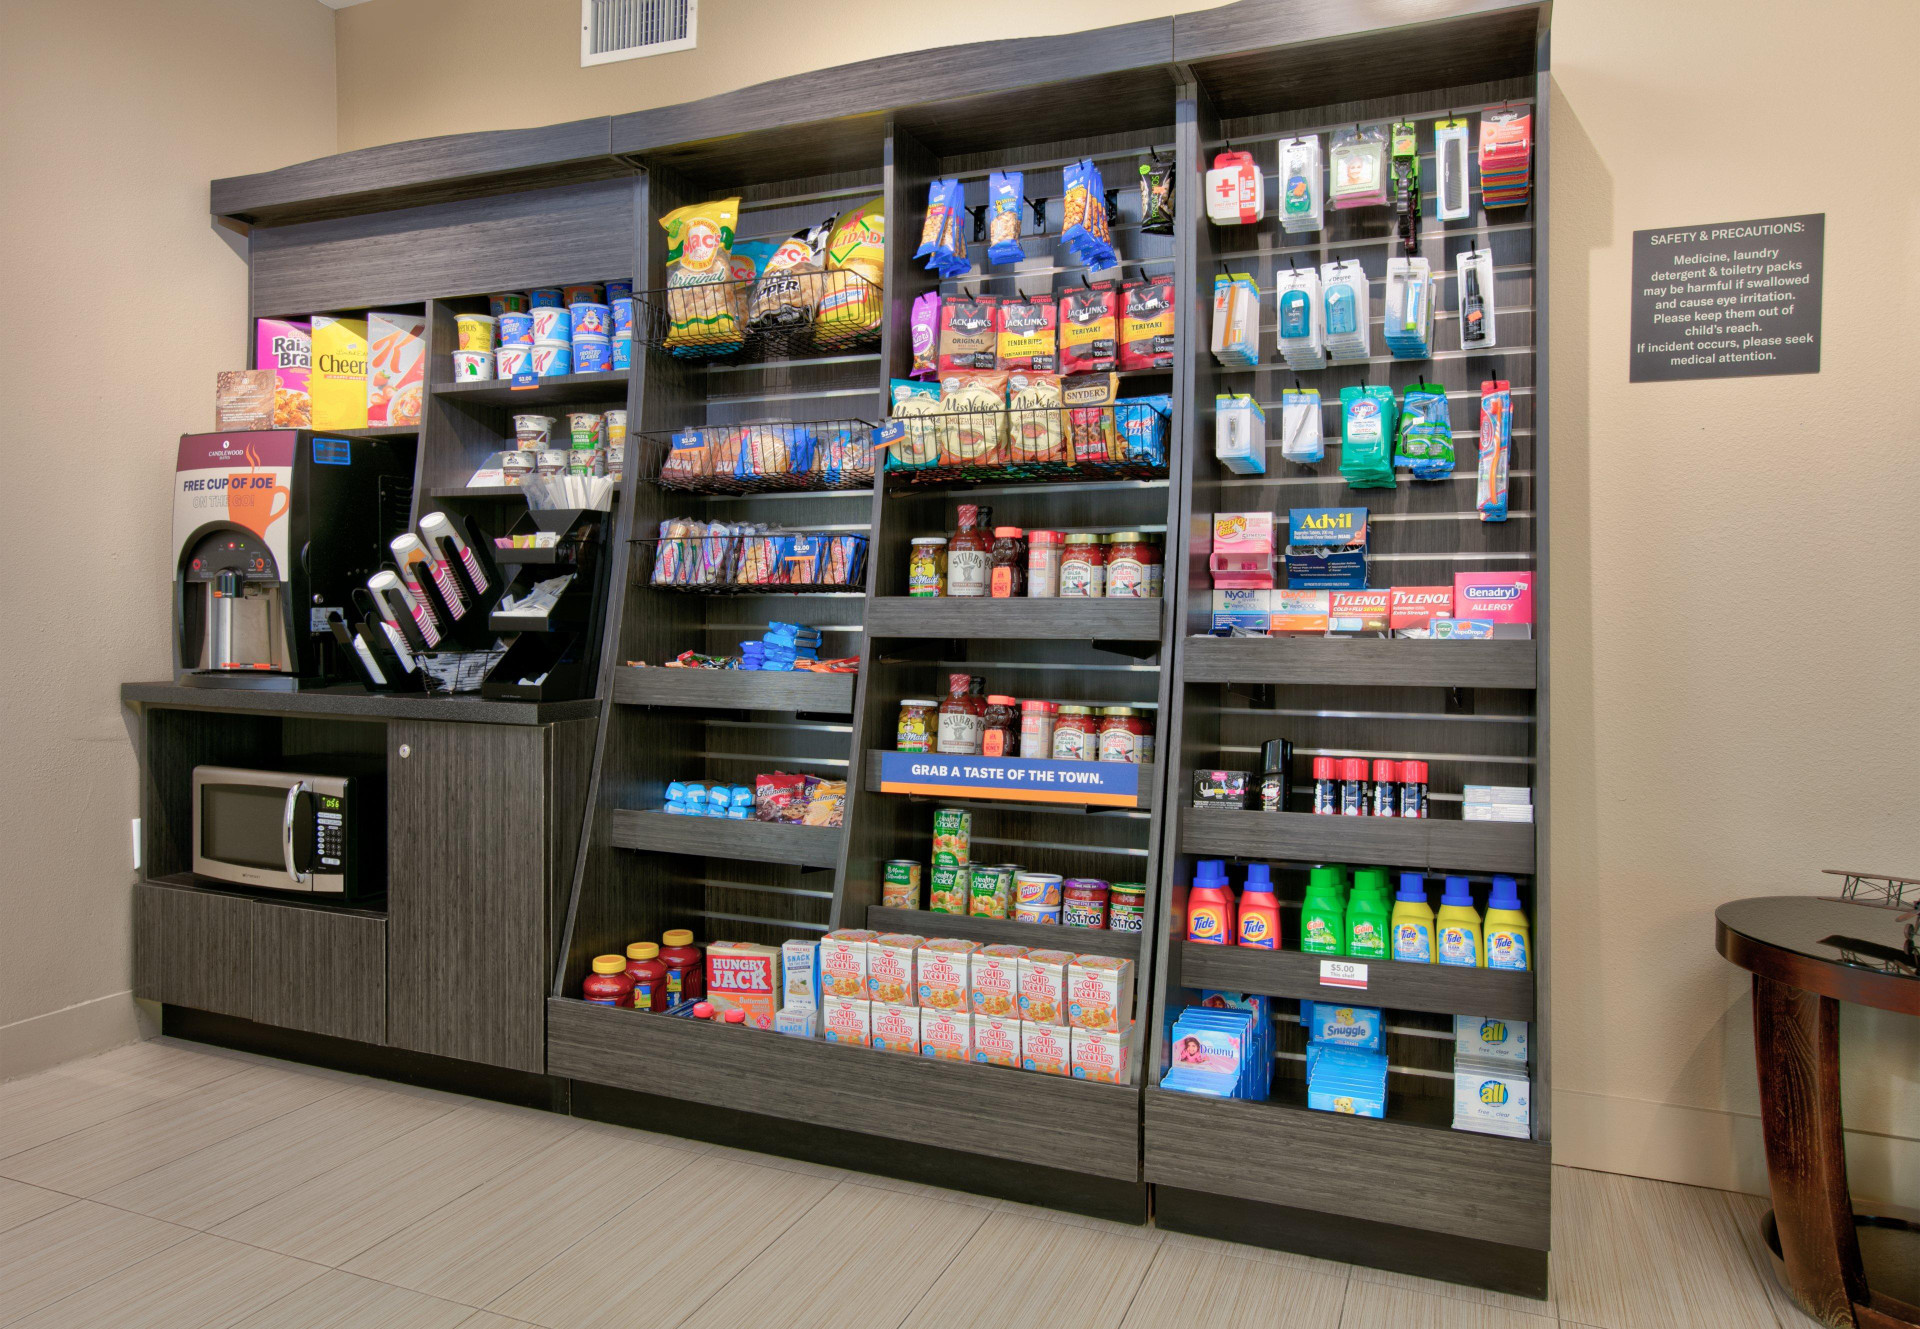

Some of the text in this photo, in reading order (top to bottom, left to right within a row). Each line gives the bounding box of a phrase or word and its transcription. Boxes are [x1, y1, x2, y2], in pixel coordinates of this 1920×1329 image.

[1650, 222, 1805, 246] SAFETY & PRECAUTIONS:
[683, 232, 722, 258] Mac's
[1674, 247, 1779, 266] Medicine, laundry
[1651, 260, 1803, 282] detergent & toiletry packs
[668, 267, 726, 290] Original
[1643, 273, 1810, 298] may be harmful if swallowed
[1655, 291, 1796, 310] and cause eye irritation.
[1067, 309, 1084, 318] JACK
[1126, 304, 1144, 314] JACK
[1653, 304, 1795, 324] Please keep them out of
[948, 318, 968, 327] JACK
[1005, 318, 1023, 328] JACK
[1131, 321, 1162, 331] TERIYAKI
[1072, 326, 1101, 335] TERIYAKI
[1684, 322, 1763, 336] child's reach.
[1637, 333, 1814, 353] If incident occurs, please seek
[1670, 350, 1777, 366] medical attention.
[1066, 387, 1107, 400] SNYDER'S
[943, 394, 1000, 416] Miss Vickie's
[881, 427, 898, 438] $2.00
[681, 436, 697, 444] $2.00
[208, 449, 244, 457] CANDLEWOOD
[183, 477, 273, 492] FREE CUP OF JOE
[192, 494, 255, 509] ON THE GO!
[1300, 513, 1353, 529] Advil
[793, 543, 810, 552] $2.00
[1224, 590, 1255, 601] NyQuil
[1280, 589, 1317, 599] DayQuil
[1332, 593, 1388, 606] TYLENOL
[1392, 591, 1451, 605] TYLENOL
[1469, 587, 1515, 600] Benadryl
[1471, 603, 1514, 611] ALLERGY
[911, 764, 1104, 785] GRAB A TASTE OF THE TOWN.
[936, 820, 959, 828] Choice
[933, 876, 954, 885] Choice
[972, 880, 995, 889] Choice
[1064, 910, 1101, 925] TOSTITOS
[1193, 916, 1215, 932] Tide
[1243, 919, 1265, 935] Tide
[1306, 920, 1325, 931] Gain
[1353, 924, 1374, 935] Gain
[1400, 929, 1417, 940] Tide
[1446, 933, 1462, 944] Tide
[1495, 937, 1513, 949] Tide
[787, 954, 811, 962] SNACK
[834, 953, 852, 962] CUP
[879, 957, 898, 967] CUP
[712, 958, 766, 971] HUNGRY
[826, 960, 860, 972] NOODLES
[872, 964, 905, 977] NOODLES
[932, 963, 952, 973] CUP
[1330, 963, 1355, 973] $5.00
[711, 970, 770, 990] JACK
[923, 971, 959, 983] NOODLES
[984, 969, 1004, 979] CUP
[1030, 974, 1049, 985] CUP
[977, 976, 1010, 988] NOODLES
[1082, 981, 1103, 991] CUP
[1022, 981, 1055, 996] NOODLES
[1074, 988, 1110, 1001] NOODLES
[836, 1010, 855, 1019] CUP
[885, 1016, 905, 1025] CUP
[829, 1016, 863, 1028] NOODLES
[935, 1023, 955, 1033] CUP
[877, 1023, 912, 1035] NOODLES
[987, 1030, 1006, 1040] CUP
[1327, 1025, 1366, 1038] Snuggle
[1481, 1023, 1505, 1041] all
[927, 1029, 962, 1042] NOODLES
[980, 1037, 1013, 1050] NOODLES
[1035, 1037, 1055, 1047] CUP
[1028, 1043, 1062, 1057] NOODLES
[1086, 1044, 1106, 1054] CUP
[1200, 1044, 1234, 1059] Downy
[1077, 1051, 1113, 1065] NOODLES
[1481, 1084, 1505, 1104] all
